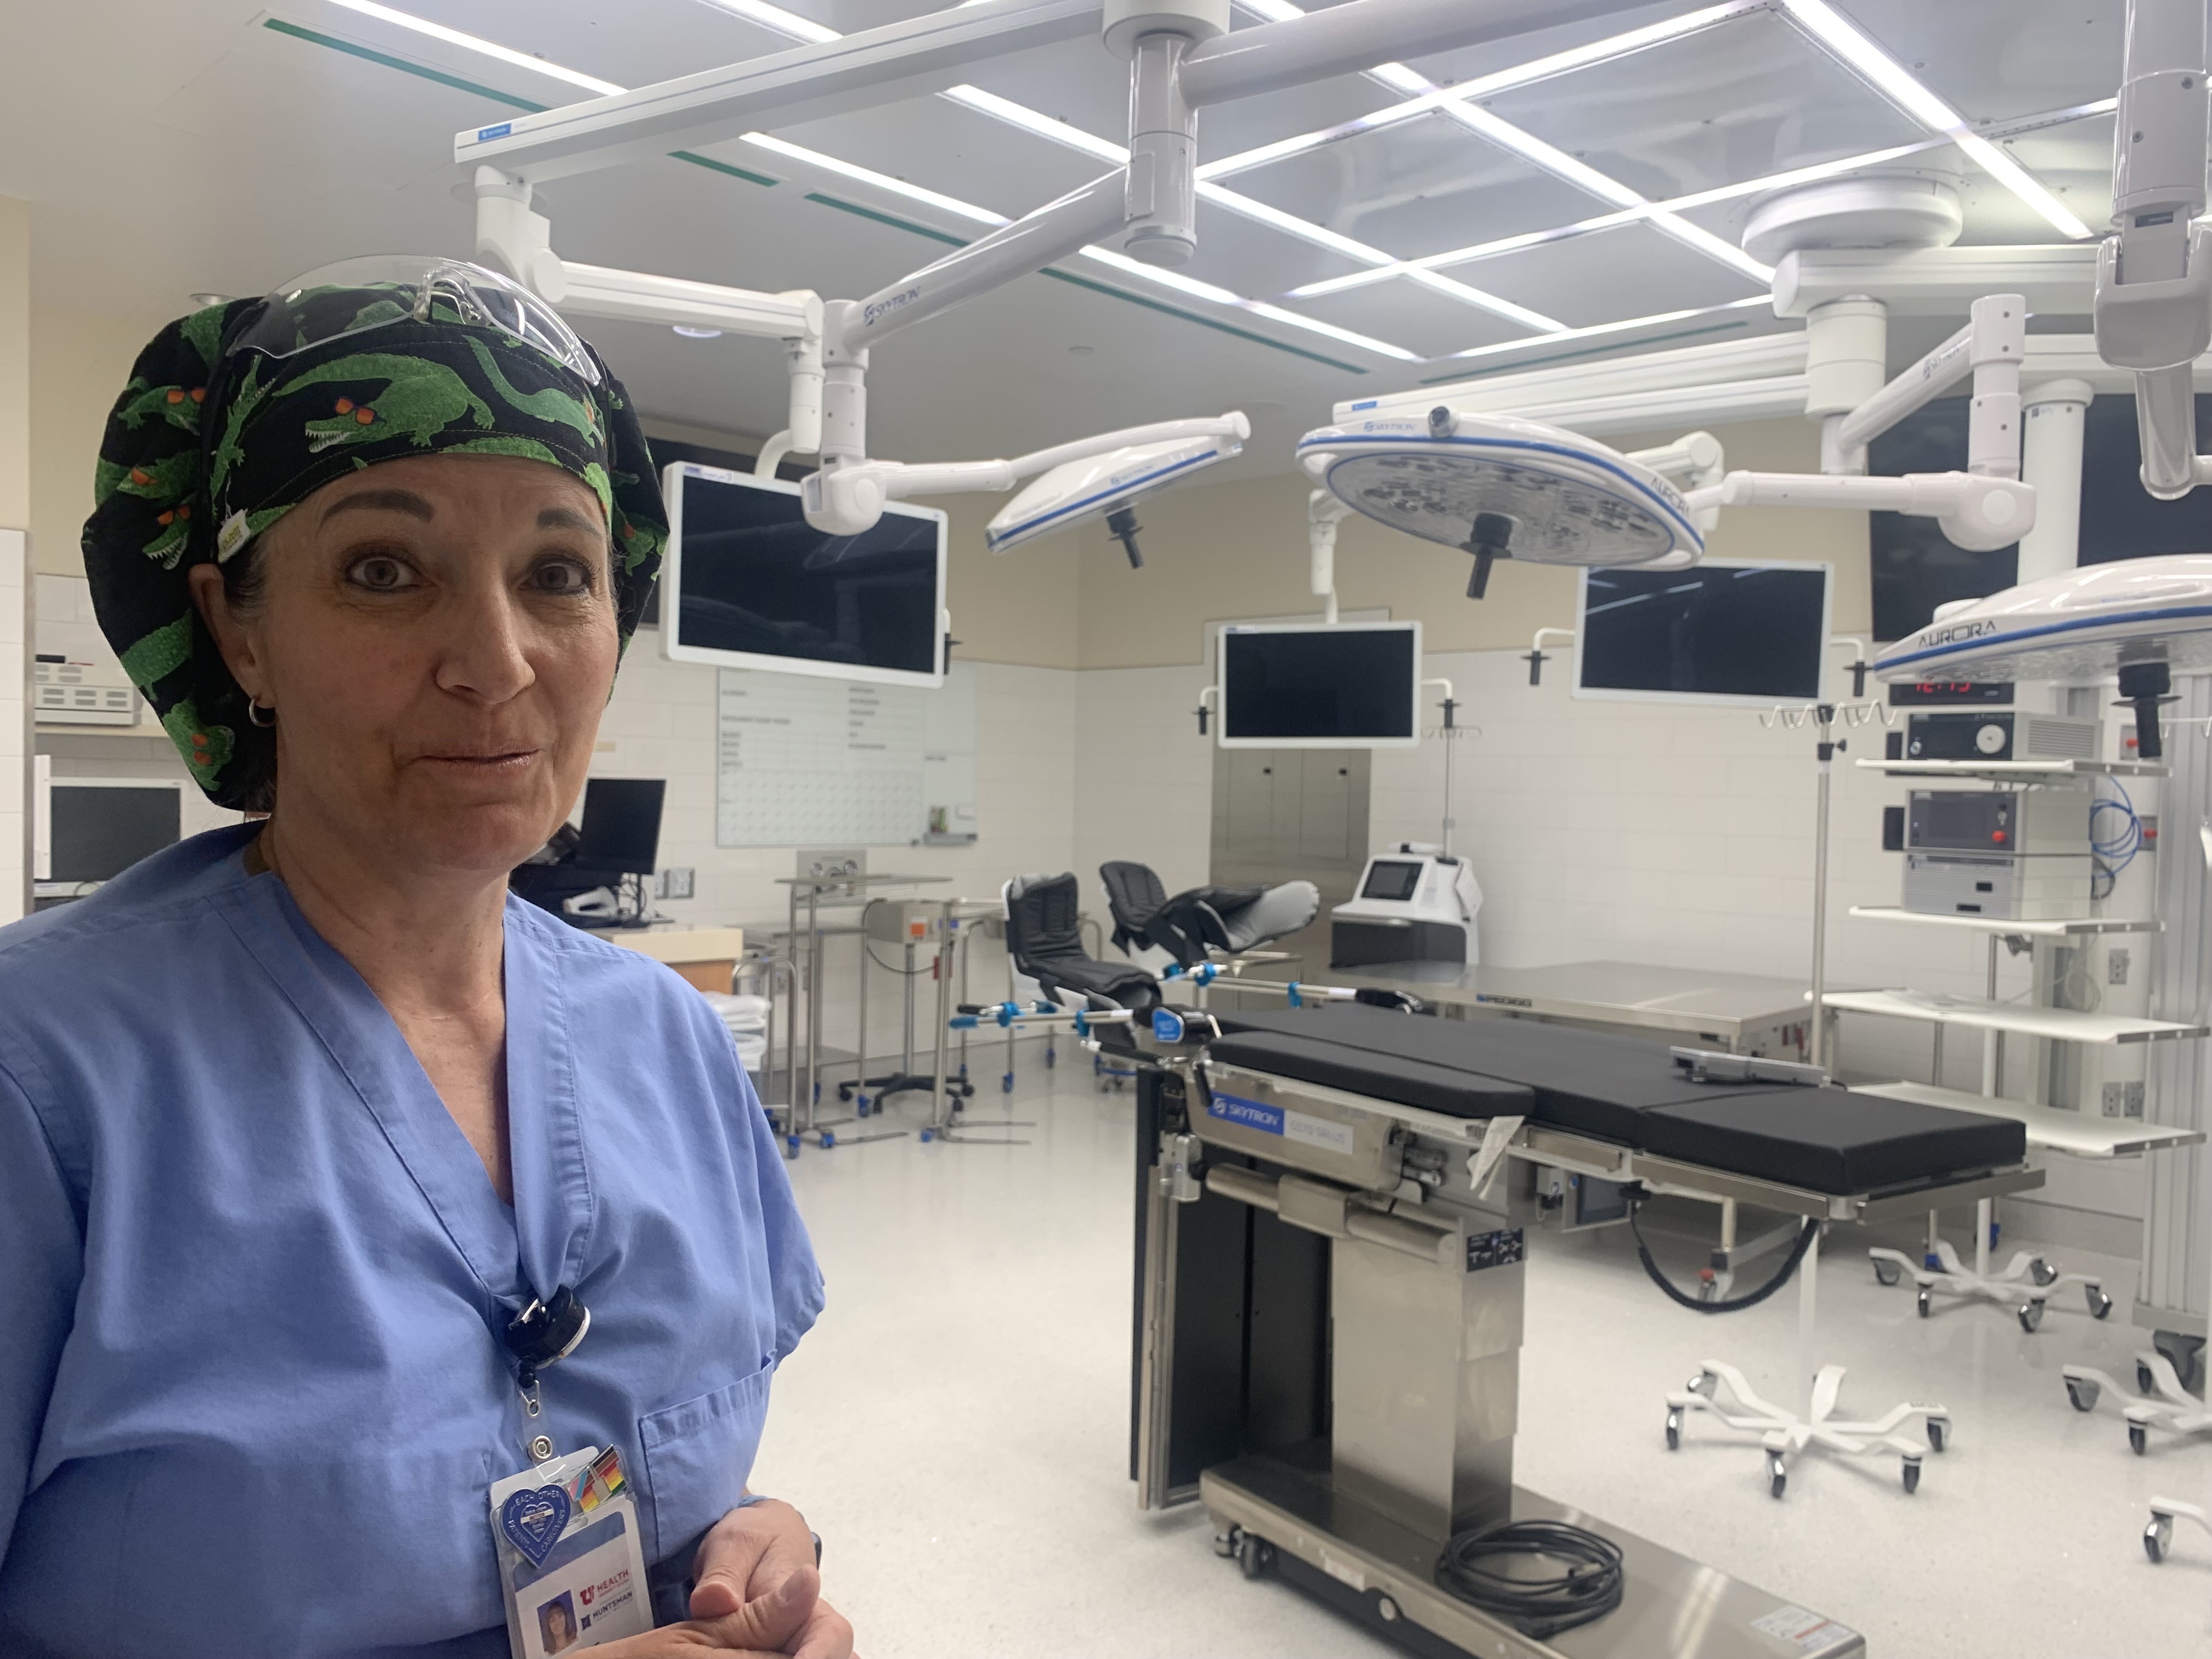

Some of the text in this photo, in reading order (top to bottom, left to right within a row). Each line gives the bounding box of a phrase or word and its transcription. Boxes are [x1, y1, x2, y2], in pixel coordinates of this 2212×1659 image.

[1918, 619, 1997, 648] AURORA
[1228, 1103, 1280, 1126] SKYTRON
[538, 1490, 560, 1500] OTHER
[597, 1568, 630, 1593] HEALTH
[593, 1590, 633, 1618] HUNTSMAN
